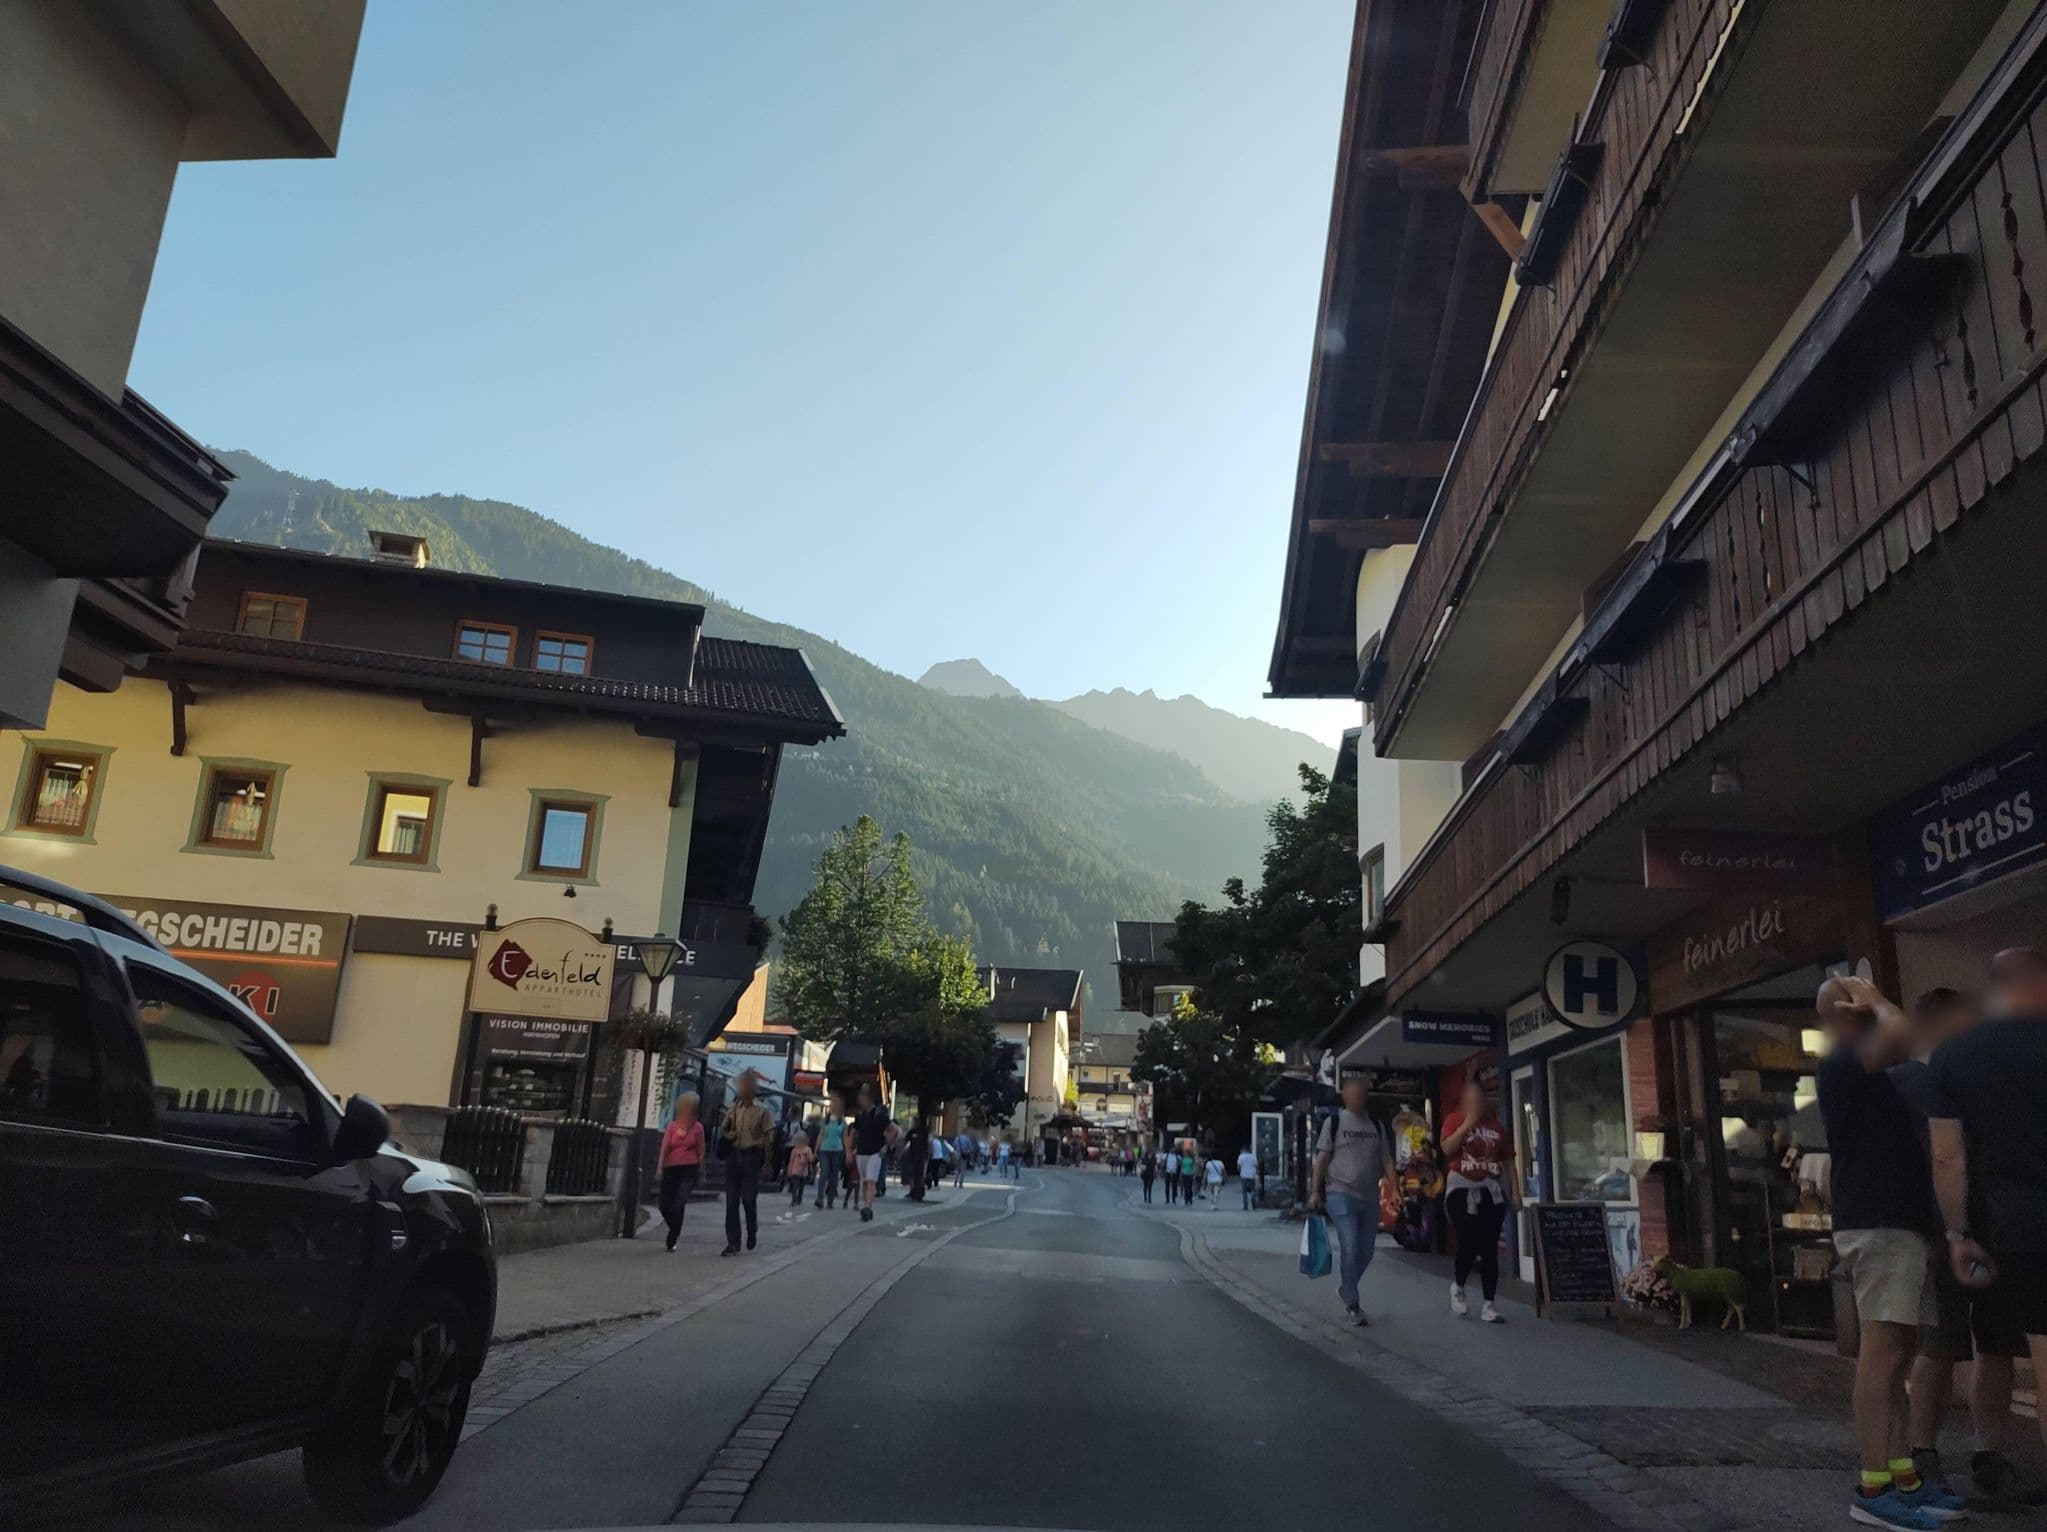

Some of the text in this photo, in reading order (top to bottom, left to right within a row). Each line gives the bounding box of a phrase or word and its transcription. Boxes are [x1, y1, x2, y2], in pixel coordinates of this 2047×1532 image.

[1941, 767, 1998, 805] Pension
[1922, 791, 2034, 873] Strass
[118, 908, 324, 957] GSCHEIDER
[426, 930, 465, 947] THE
[1683, 899, 1784, 974] feinerlei
[1564, 954, 1618, 1015] H
[489, 1019, 527, 1030] VISION
[1408, 1020, 1437, 1031] SNOW
